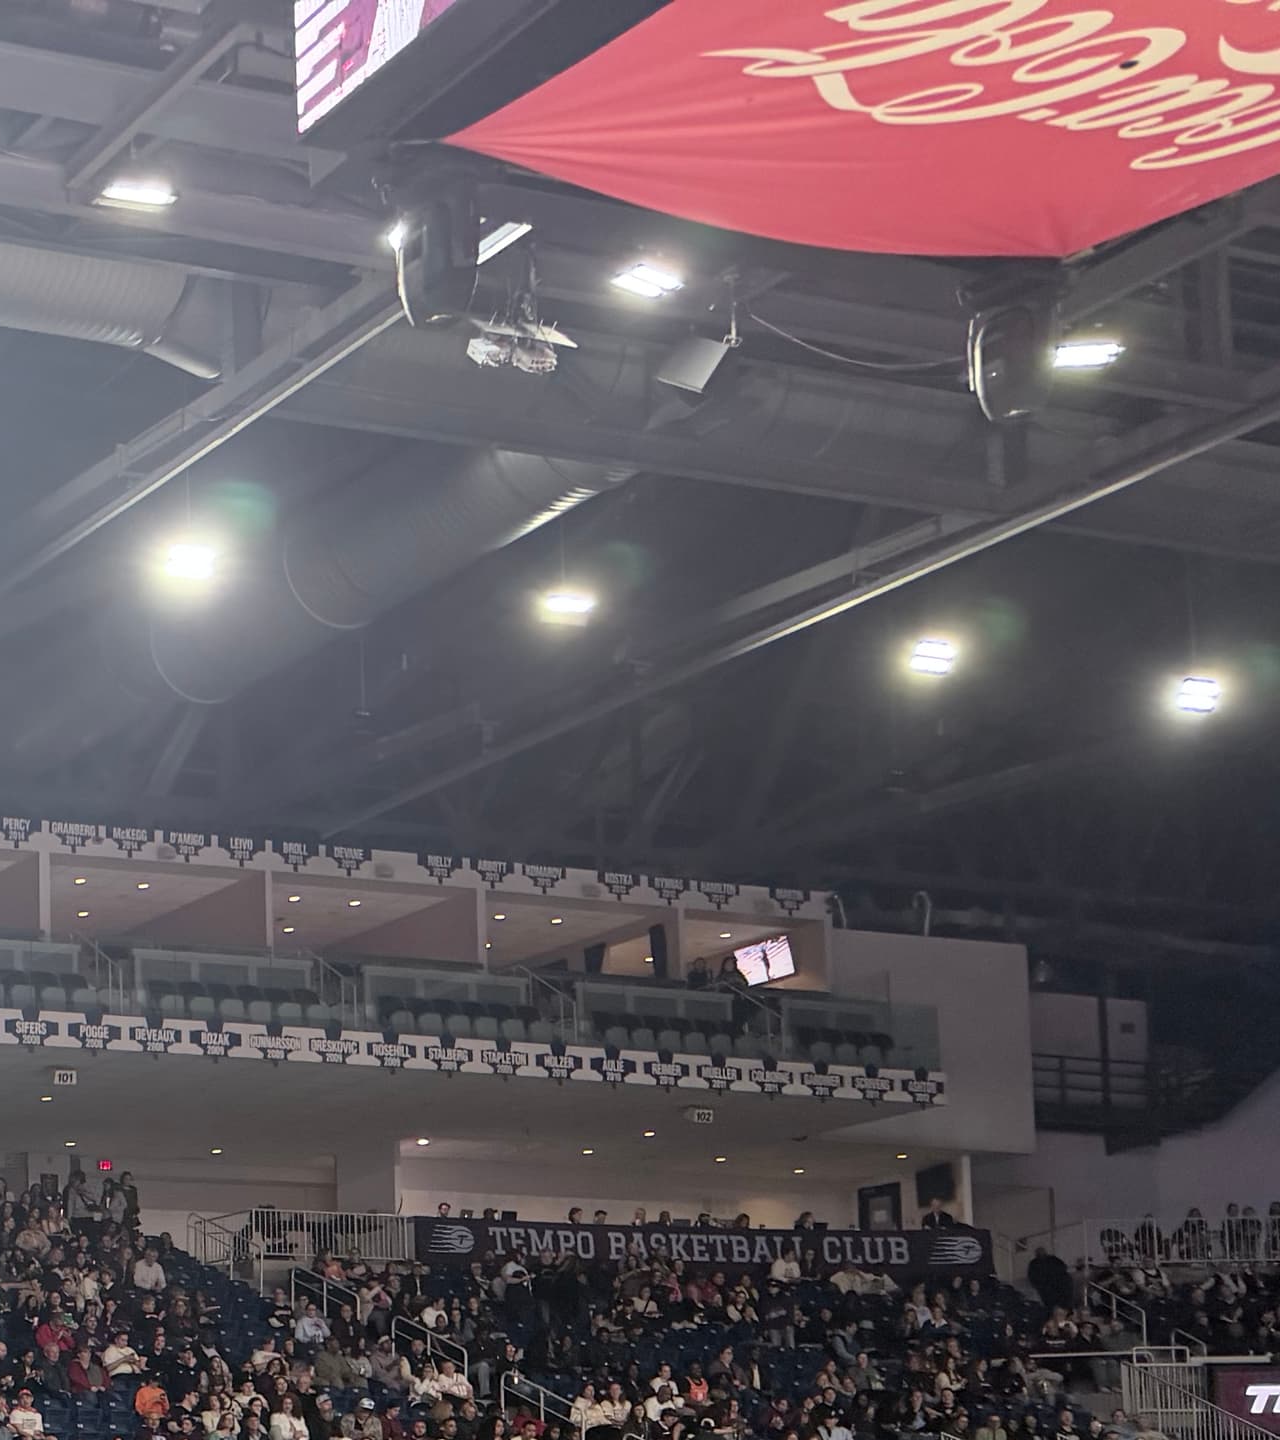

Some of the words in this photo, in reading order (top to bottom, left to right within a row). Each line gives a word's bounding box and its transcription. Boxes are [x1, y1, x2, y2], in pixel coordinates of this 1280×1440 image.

[16, 1021, 46, 1035] SIFERS
[80, 1025, 109, 1038] POGGE
[201, 1032, 229, 1045] BOZAK
[57, 1073, 73, 1083] 101
[697, 1112, 711, 1121] 102
[488, 1226, 594, 1260] TEMPO
[608, 1233, 802, 1263] BASKETBALL
[823, 1236, 910, 1265] CLUB
